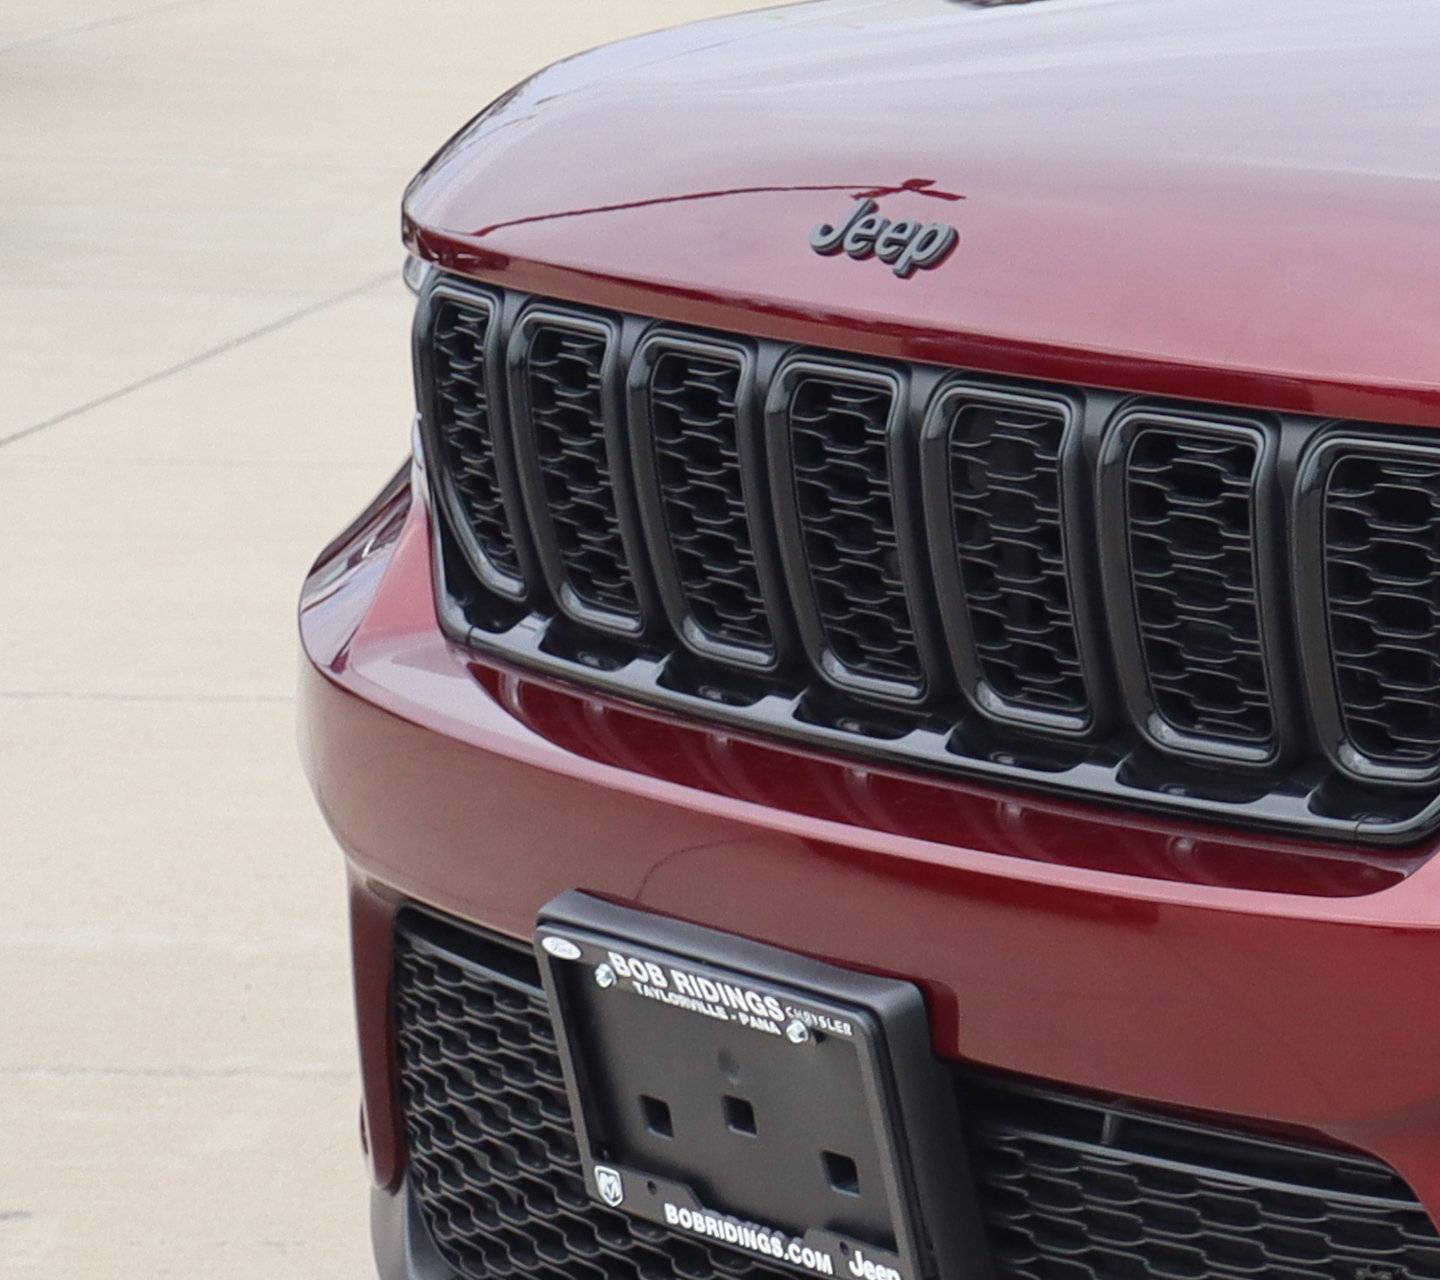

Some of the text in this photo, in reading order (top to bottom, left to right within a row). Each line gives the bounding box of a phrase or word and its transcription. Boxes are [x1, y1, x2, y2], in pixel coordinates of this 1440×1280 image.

[809, 197, 960, 280] Jeep
[607, 951, 786, 1022] BOB RIDINGS
[664, 1202, 834, 1275] BOBRIDINGS.COM
